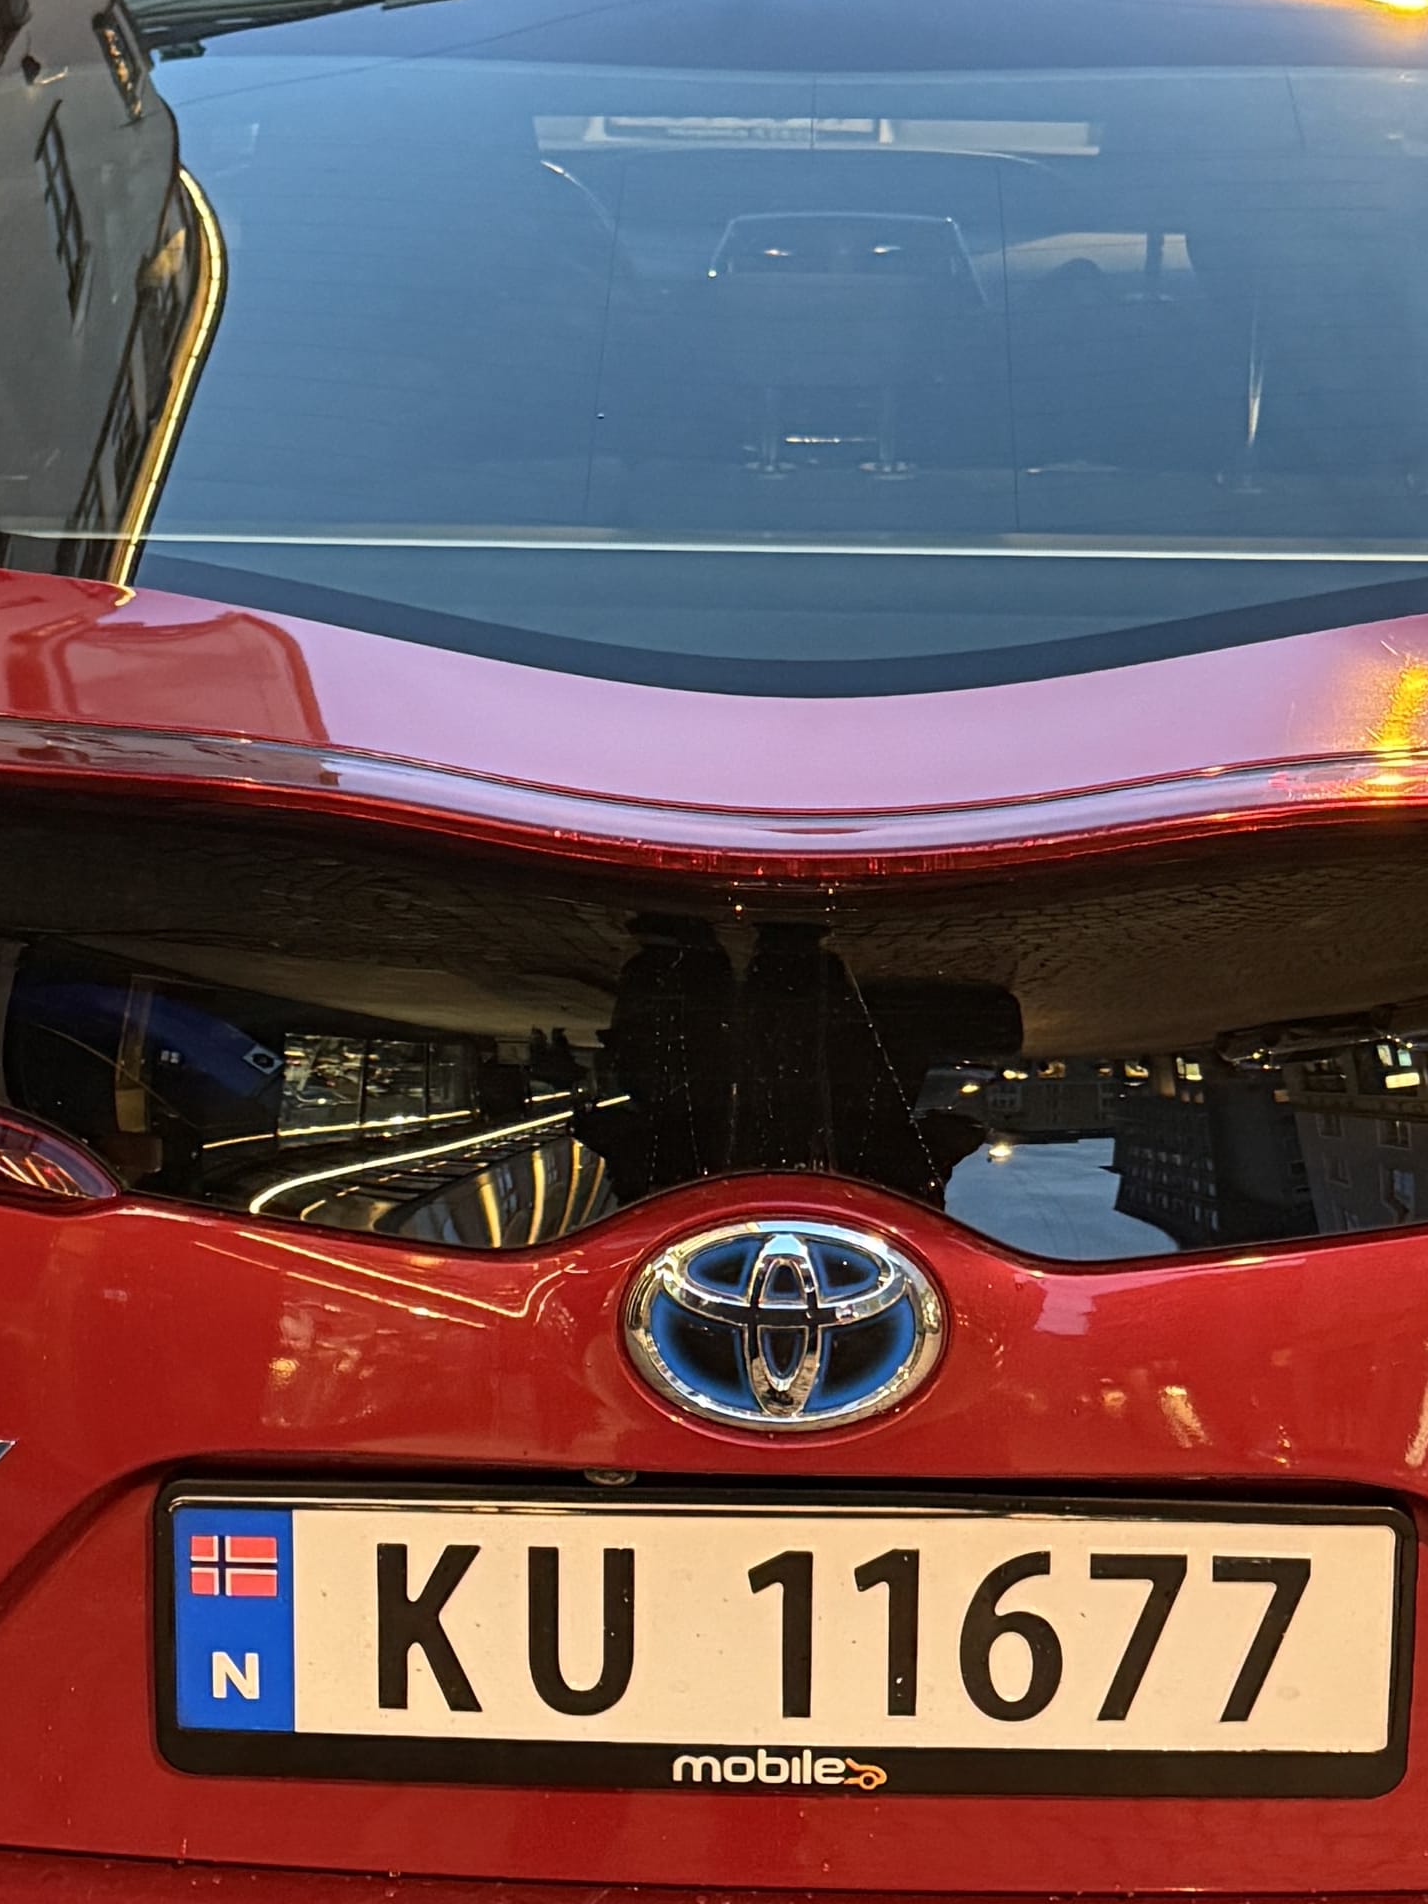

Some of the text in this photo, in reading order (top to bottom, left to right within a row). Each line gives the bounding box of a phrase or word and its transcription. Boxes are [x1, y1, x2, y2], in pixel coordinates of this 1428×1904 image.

[377, 1543, 1312, 1723] KU 11677
[212, 1651, 260, 1700] N
[673, 1748, 847, 1785] mobile
